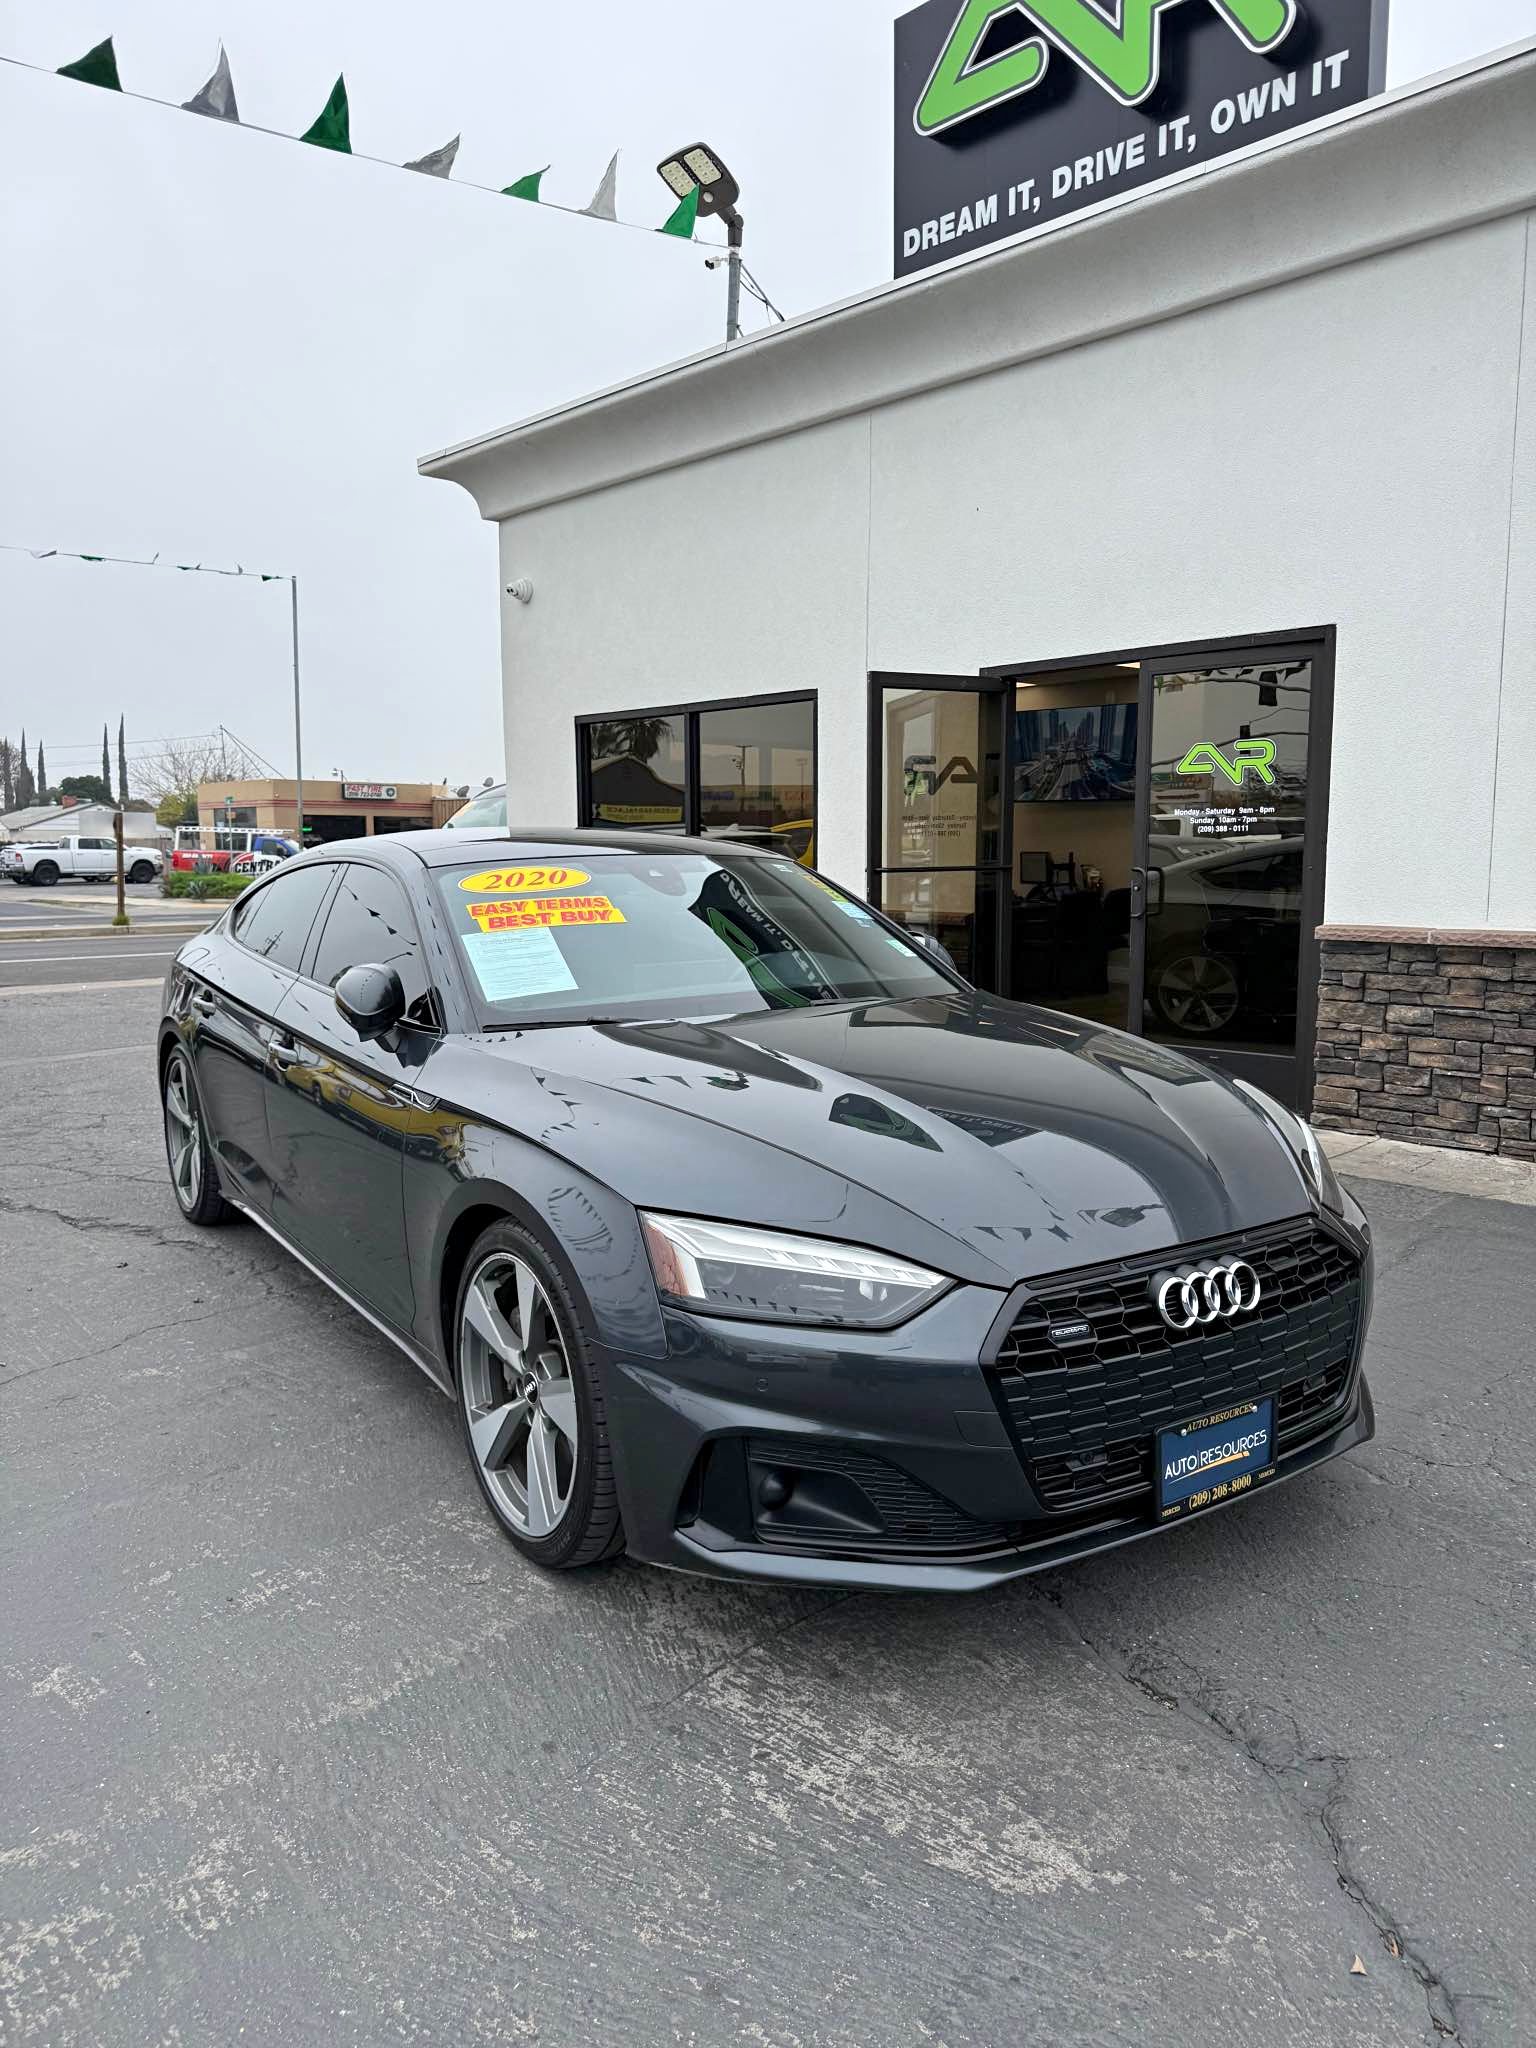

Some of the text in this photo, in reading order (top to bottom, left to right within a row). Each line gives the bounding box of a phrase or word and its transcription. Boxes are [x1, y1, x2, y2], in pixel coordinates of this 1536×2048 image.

[903, 49, 1350, 258] DREAM IT, DRIVE IT, OWN IT
[1174, 808, 1200, 816] Monday
[1205, 807, 1236, 816] Saturday
[1239, 806, 1254, 814] 9am
[1259, 806, 1275, 815] 8pm
[1190, 817, 1215, 825] Sunday
[1219, 816, 1237, 824] 10am
[1242, 816, 1258, 824] 7pm
[1197, 825, 1214, 833] (209)
[483, 870, 568, 890] 2020
[471, 897, 610, 917] EASY TERMS
[488, 909, 613, 929] BEST BUY
[1186, 1402, 1254, 1432] AUTO RESOURCES
[1164, 1429, 1267, 1479] AUTO RESOURCES
[1188, 1490, 1211, 1510] (209)
[1161, 1505, 1181, 1518] MERCED
